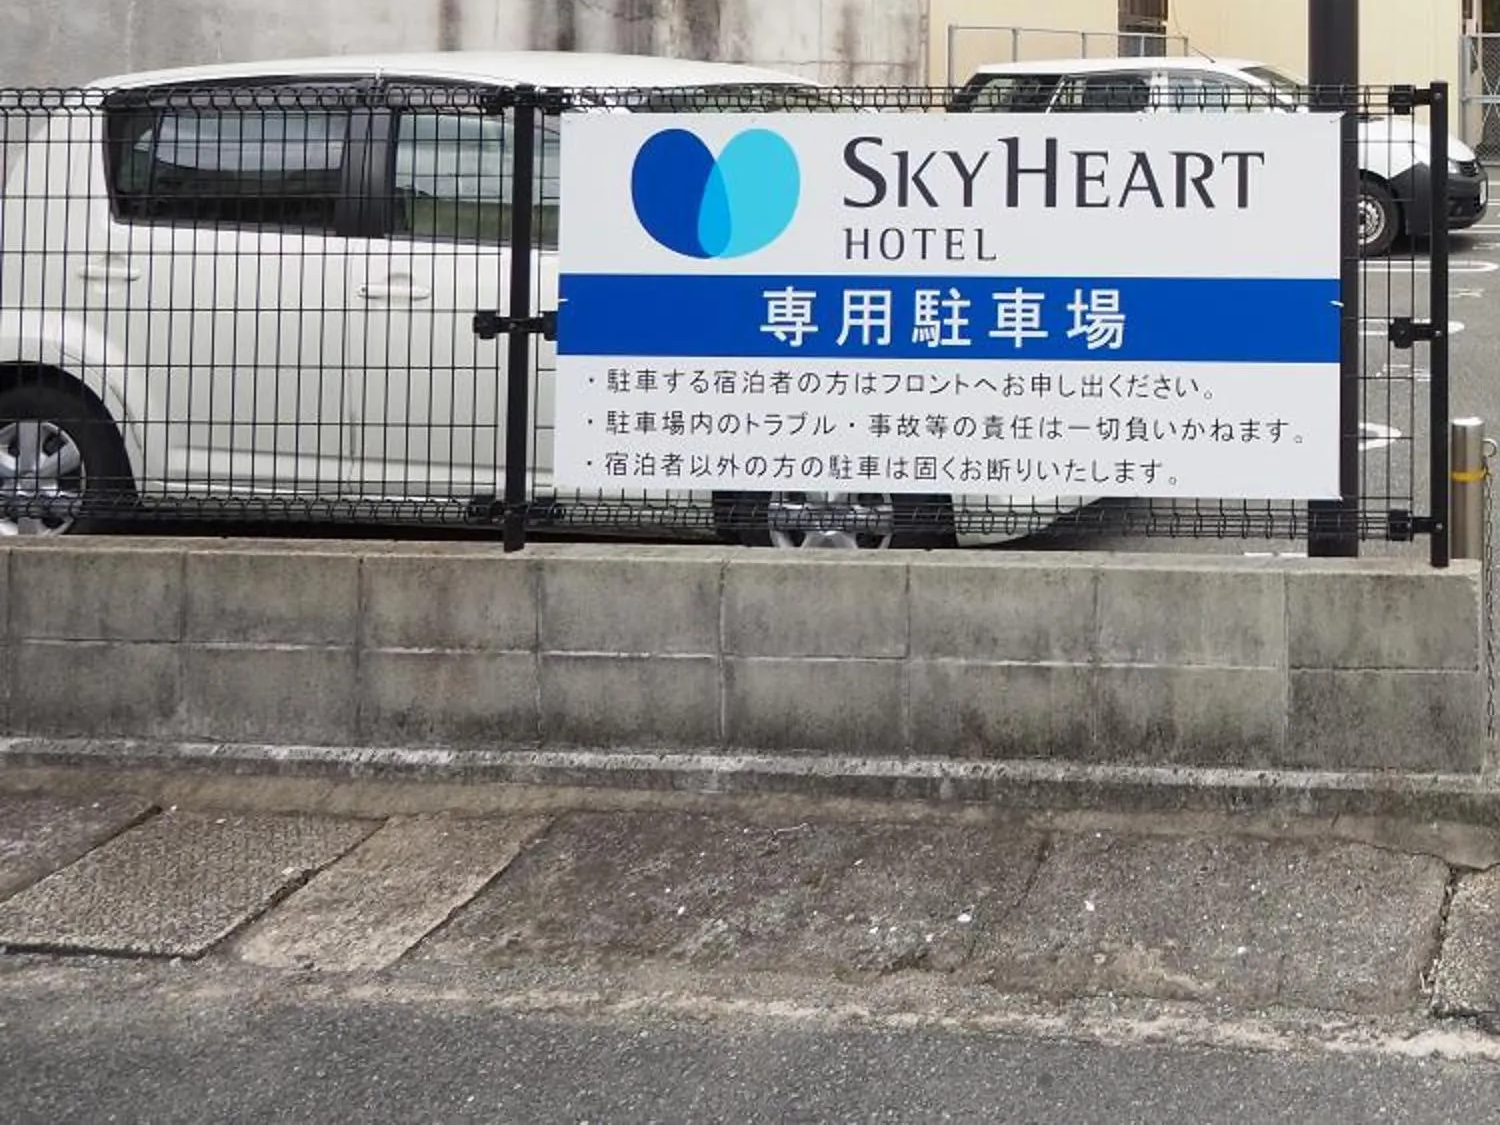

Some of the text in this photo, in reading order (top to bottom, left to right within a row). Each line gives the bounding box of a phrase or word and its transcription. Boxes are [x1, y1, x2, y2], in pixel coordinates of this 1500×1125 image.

[844, 228, 996, 261] HOTEL
[761, 287, 1125, 349] 専用駐車場
